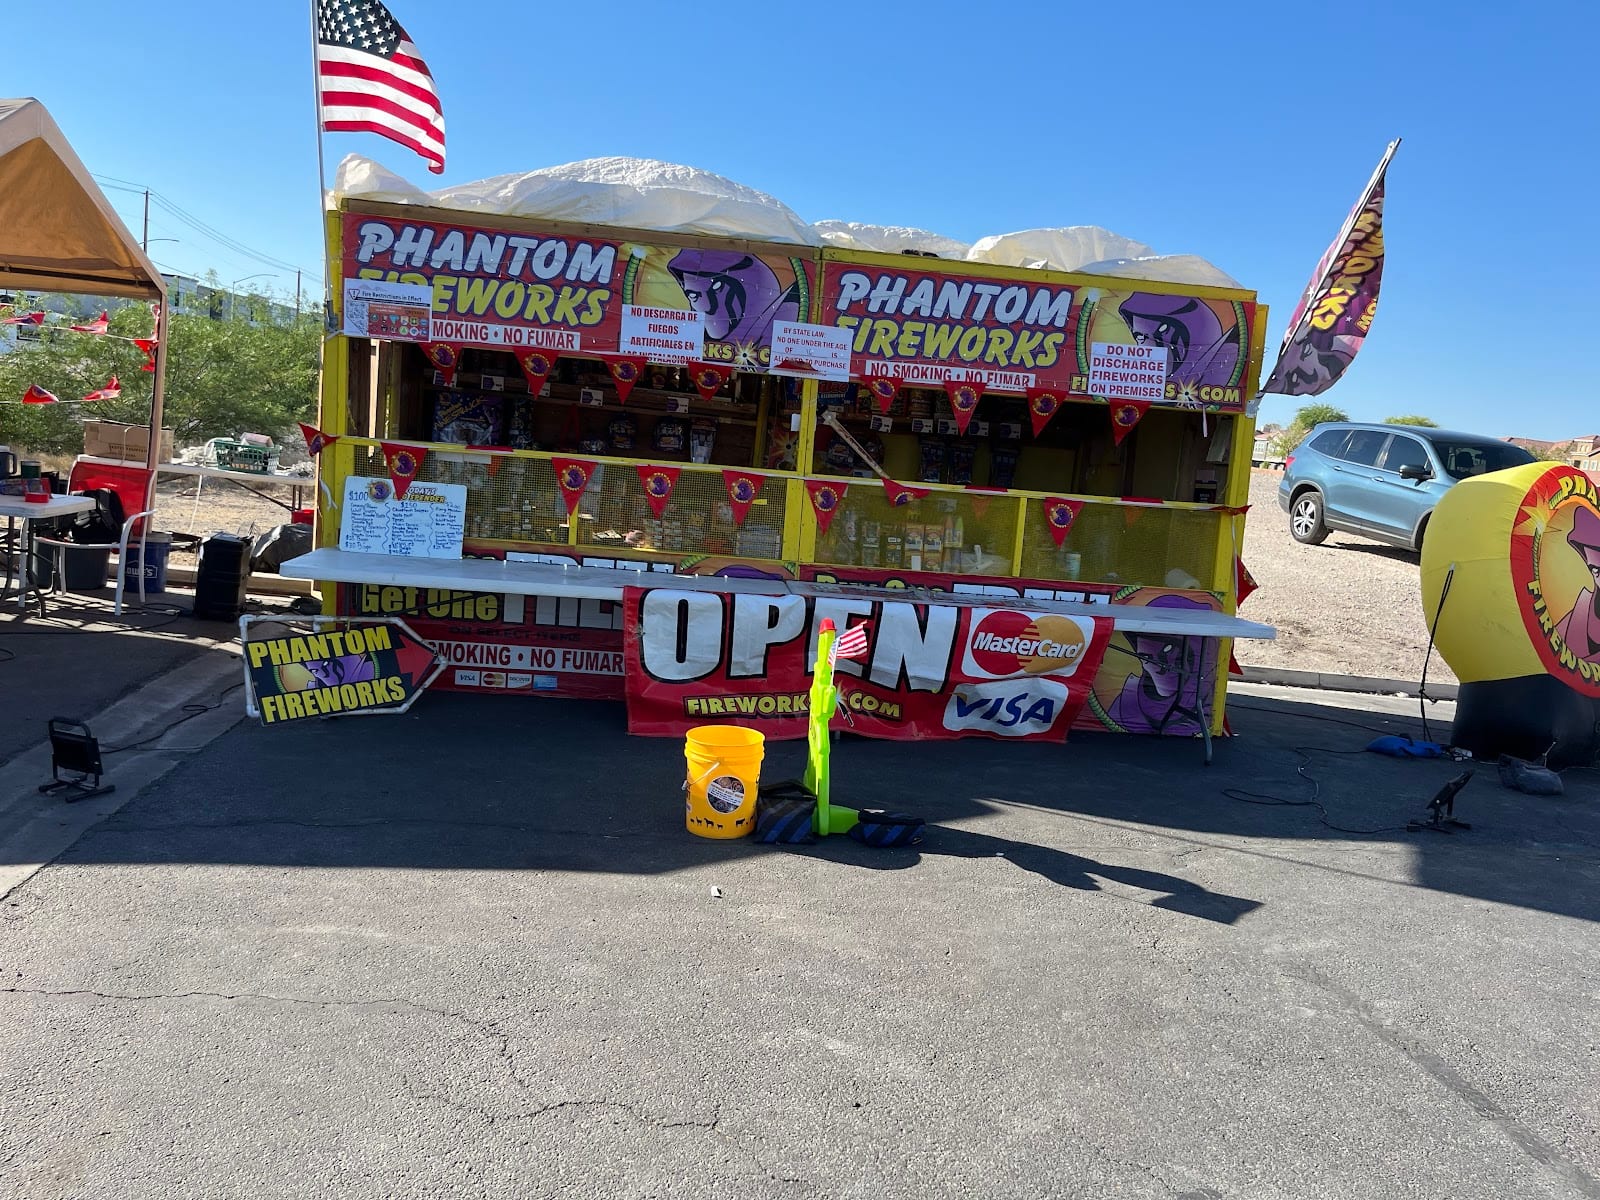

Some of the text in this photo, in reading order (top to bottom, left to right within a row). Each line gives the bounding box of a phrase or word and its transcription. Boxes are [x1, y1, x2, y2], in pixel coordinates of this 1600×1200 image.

[357, 223, 615, 284] PHANTOM
[836, 273, 1072, 328] PHANTOM
[631, 307, 698, 322] NO DESCARGA DE
[433, 320, 575, 350] MOKING NO FUMAR
[648, 323, 679, 335] FUEGOS
[793, 328, 811, 337] STATE
[630, 336, 695, 351] ARTIFICIALES EN
[787, 337, 801, 345] ONE
[801, 339, 822, 348] UNDER
[823, 341, 835, 349] THE
[835, 343, 849, 351] AGE
[1106, 345, 1153, 358] DO NOT
[814, 359, 847, 370] PURCHASE
[871, 362, 890, 379] NO
[892, 363, 951, 381] SMOKING
[965, 370, 983, 384] NO
[1093, 357, 1164, 372] DISCHARGE
[1091, 370, 1163, 385] FIREWORKS
[1090, 383, 1106, 394] ON
[1109, 384, 1162, 398] PREMISES
[349, 490, 369, 501] $100
[1558, 474, 1600, 507] PHA
[427, 589, 498, 621] One
[247, 625, 392, 668] PHANTOM
[642, 588, 958, 692] OPEN
[973, 631, 1083, 659] MasterCard
[530, 647, 556, 669] NO
[562, 649, 624, 673] FUMAR
[261, 676, 407, 724] FIREWORKS
[687, 695, 813, 717] FIREWORK
[956, 692, 1055, 727] VISA
